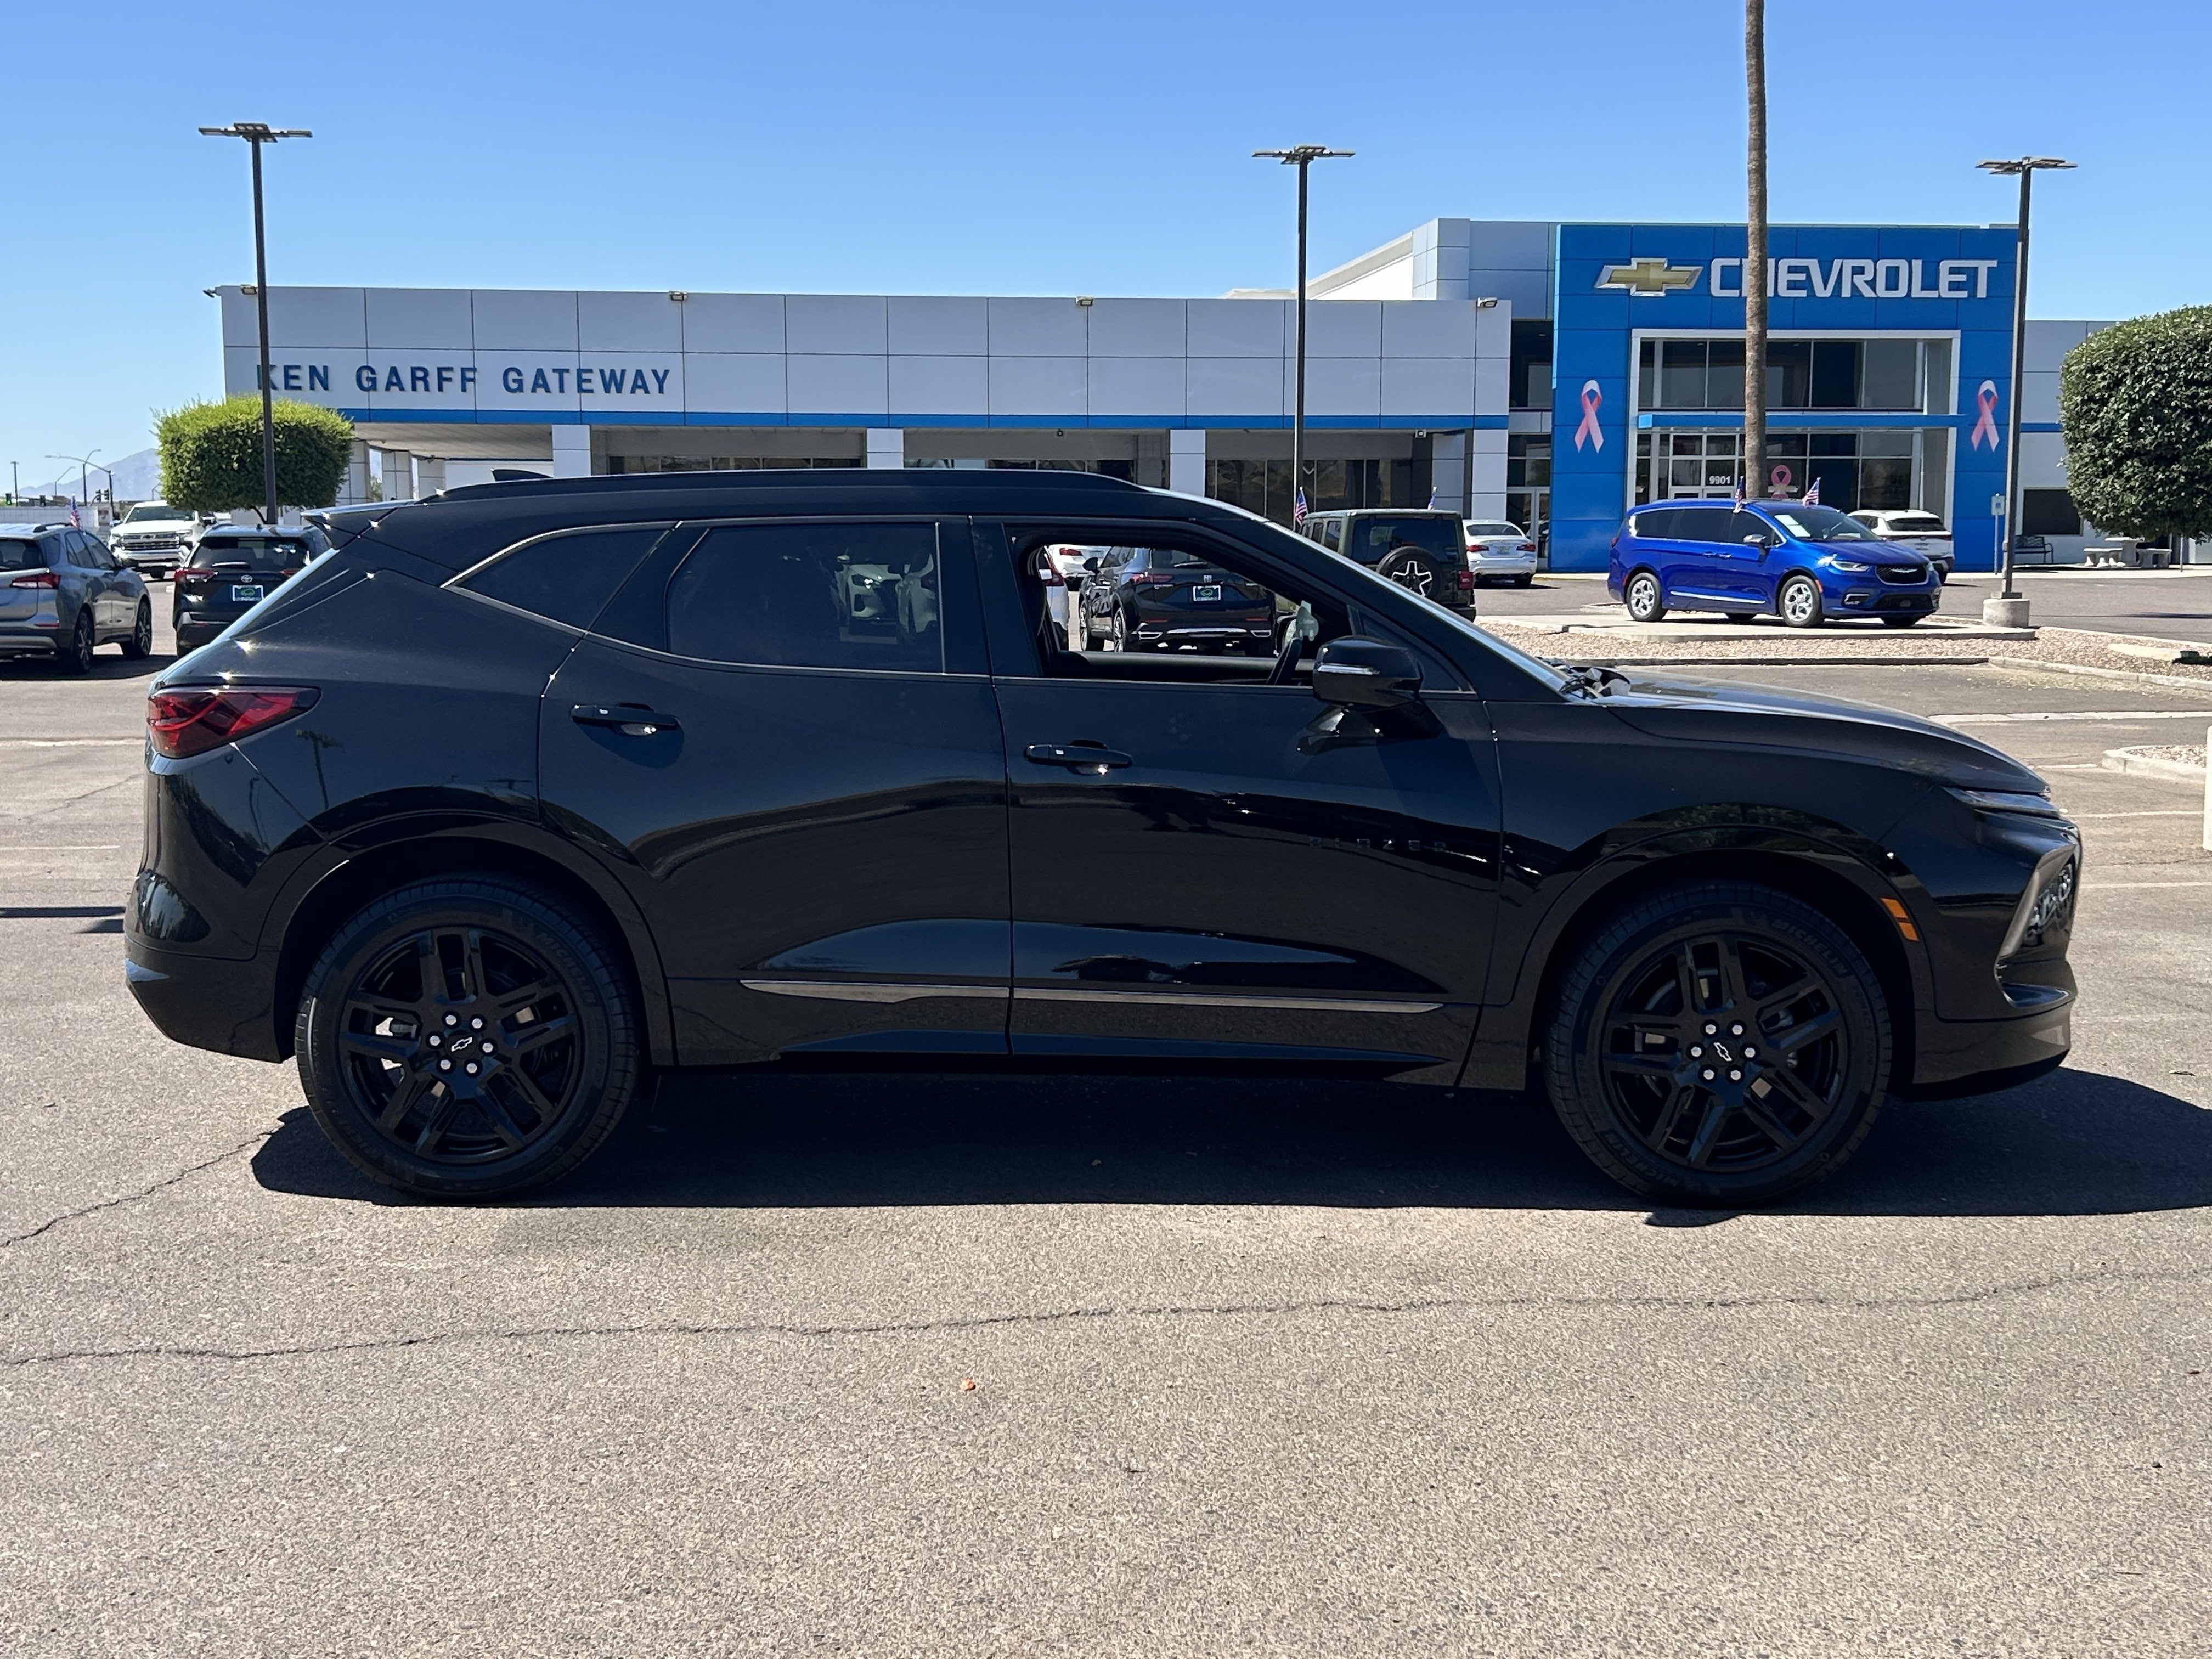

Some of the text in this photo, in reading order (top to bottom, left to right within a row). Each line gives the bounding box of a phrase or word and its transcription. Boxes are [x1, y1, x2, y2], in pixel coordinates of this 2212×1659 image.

[1711, 258, 1998, 298] CHEVROLET
[257, 365, 670, 394] KEN GARFF GATEWAY
[1709, 475, 1731, 484] 9901
